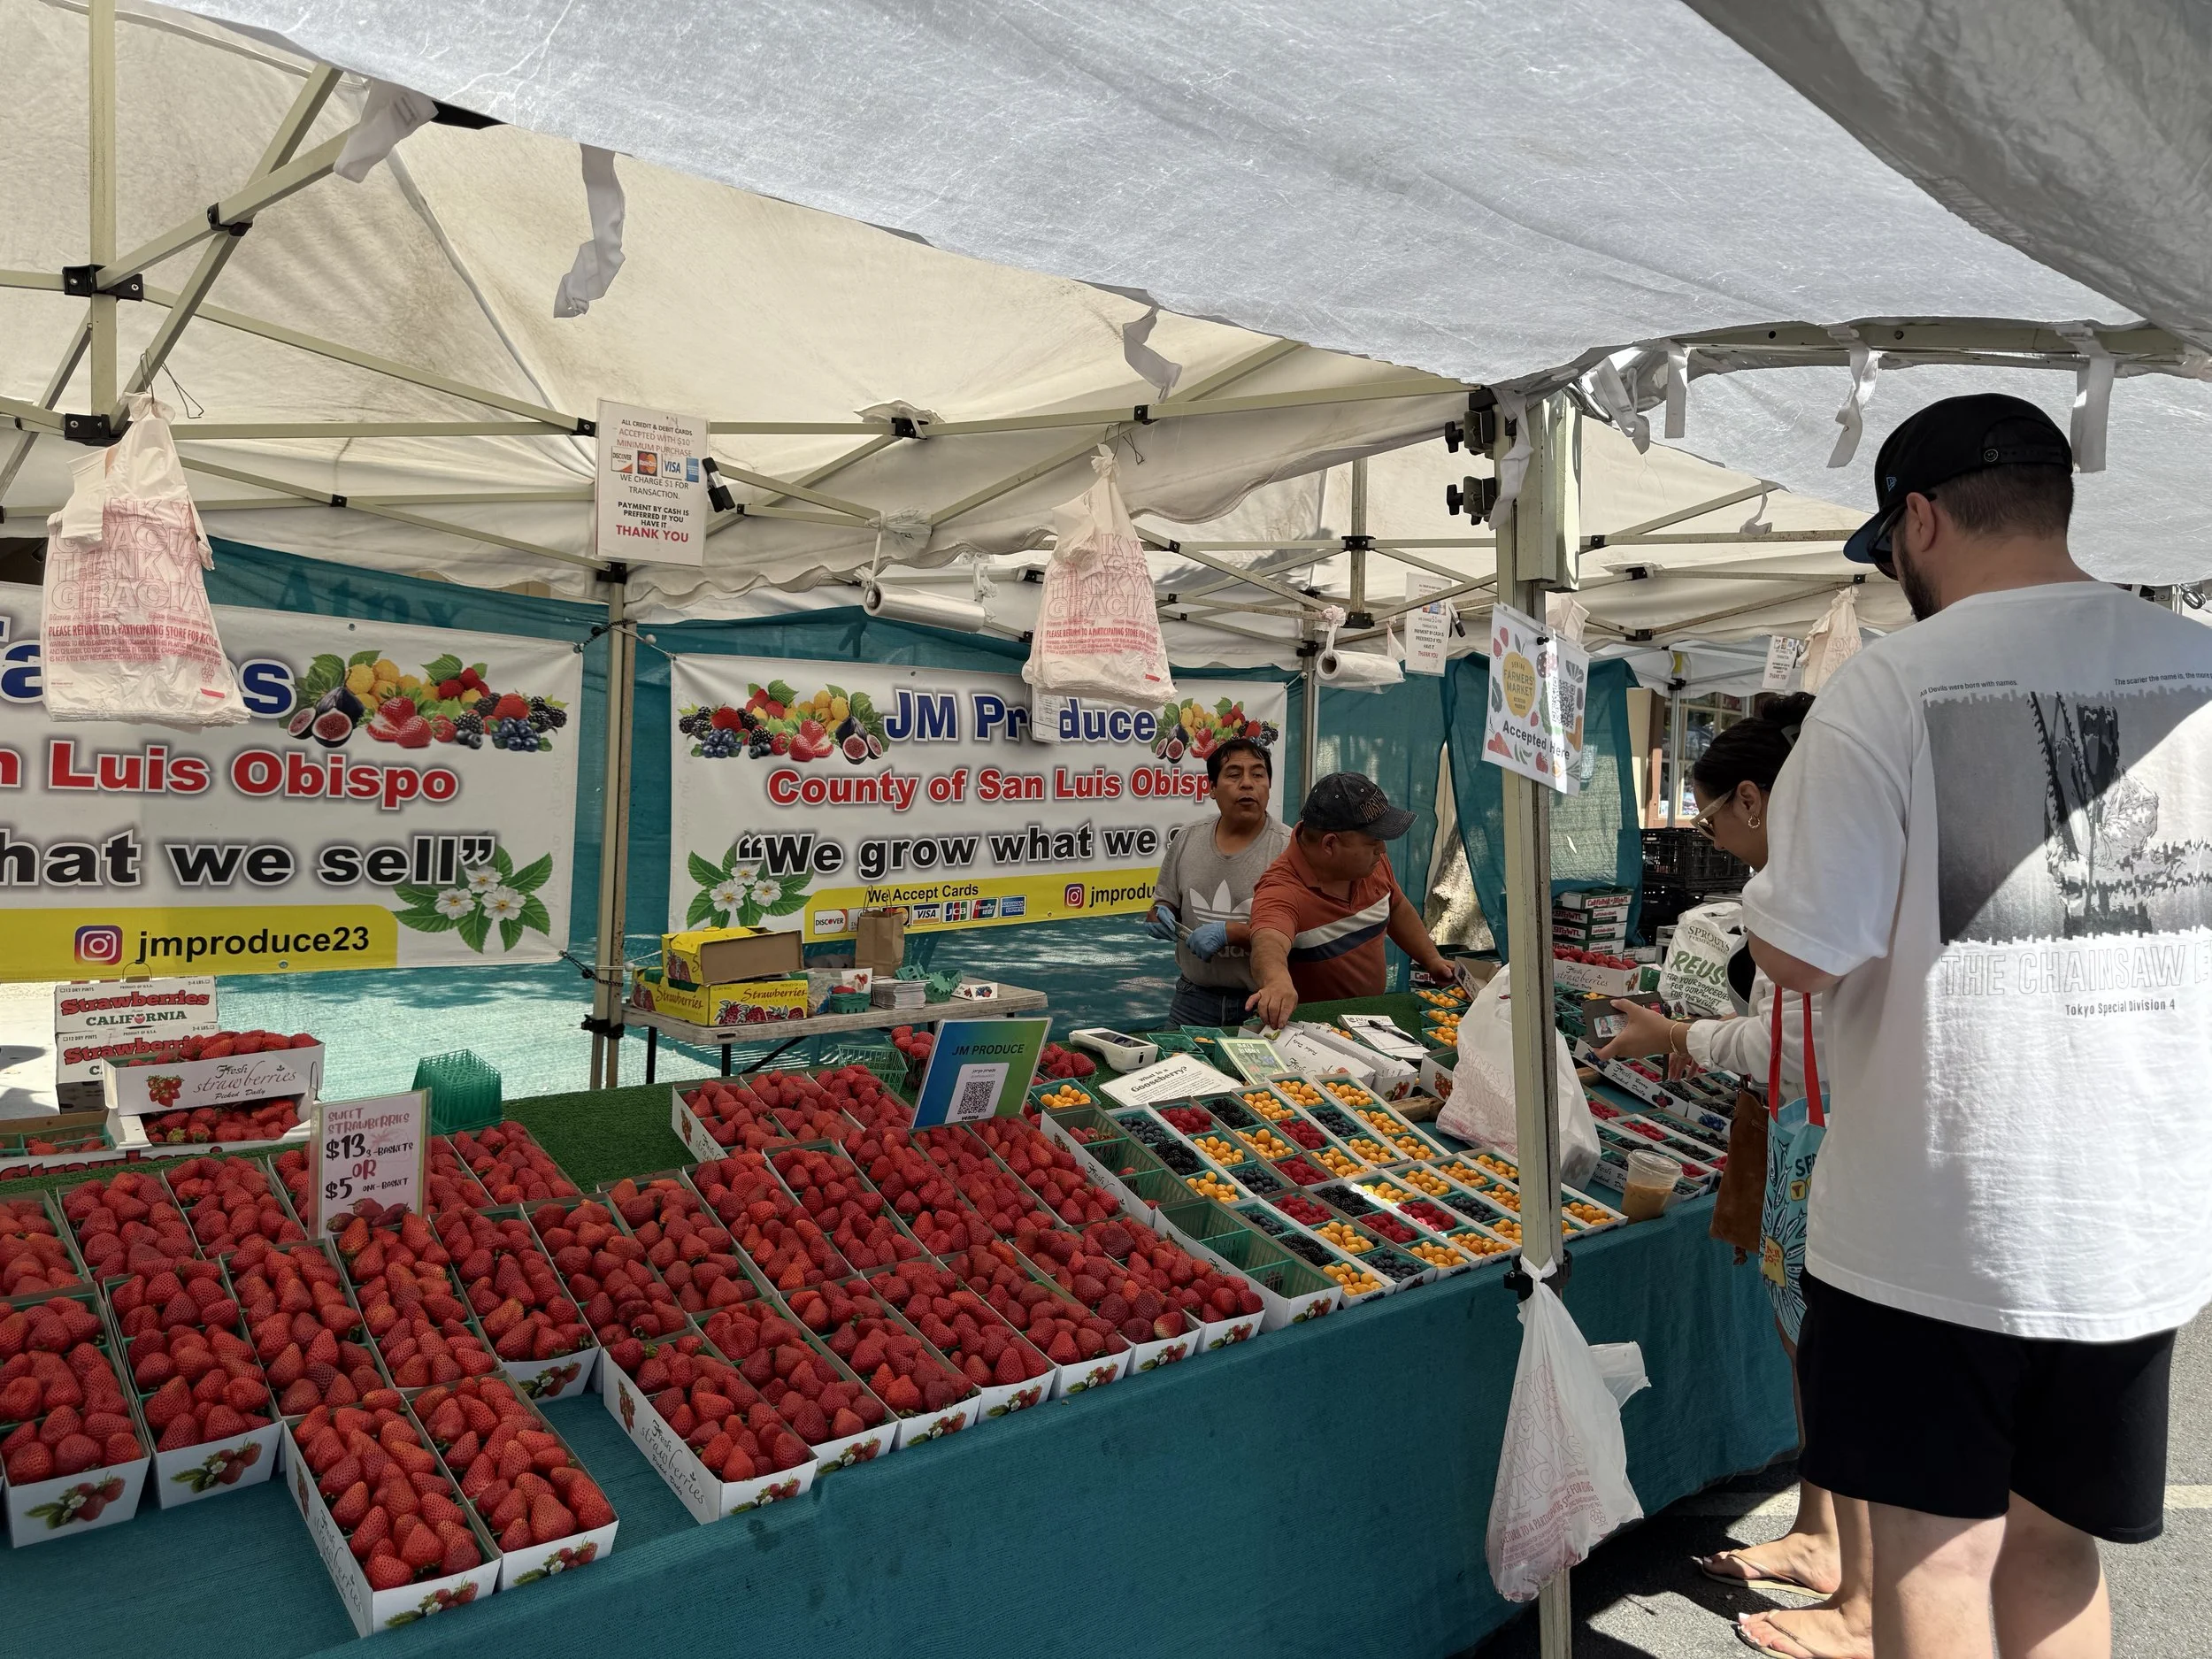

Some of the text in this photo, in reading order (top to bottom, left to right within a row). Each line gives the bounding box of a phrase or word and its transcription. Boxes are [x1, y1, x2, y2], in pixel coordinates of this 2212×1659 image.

[618, 428, 691, 446] ACCEPTED WITH $10
[632, 420, 651, 429] CREDIT
[675, 427, 693, 436] CARDS
[617, 439, 693, 457] MINIMUM PURCHASE
[664, 460, 681, 474] VISA
[619, 473, 633, 482] WE
[634, 475, 664, 486] CHARGE
[675, 480, 689, 489] FOR
[628, 486, 680, 500] TRANSACTION.
[618, 501, 652, 511] PAYMENT
[664, 506, 682, 515] CASH
[623, 510, 660, 519] PREFERRED
[616, 525, 689, 542] THANK YOU
[52, 579, 207, 617] GRACIA
[49, 626, 71, 637] PLEASE
[73, 625, 99, 636] RETURN
[100, 624, 109, 634] TO
[111, 625, 117, 635] A
[1507, 682, 1532, 698] MARKET
[883, 688, 960, 742] JM
[973, 693, 1156, 743] Prduce
[1502, 720, 1571, 760] Accepted Here
[49, 740, 211, 795] Luis
[231, 749, 459, 810] Obispo
[767, 767, 1211, 811] County of San Luis Obisp
[0, 828, 142, 886] hat
[165, 844, 296, 886] we
[858, 836, 977, 880] grow
[990, 822, 1094, 863] what
[1103, 827, 1158, 856] we
[868, 884, 979, 904] We Accept Cards
[1089, 883, 1155, 907] jmprodu
[917, 909, 936, 919] VISA
[947, 906, 967, 917] JCB
[815, 917, 844, 926] DISCOVER
[135, 926, 369, 964] jmproduce23
[1687, 926, 1731, 952] SPROUTS
[1555, 968, 1608, 987] strawberries
[1671, 950, 1727, 987] REUS
[1941, 955, 2006, 996] THE
[2018, 945, 2185, 995] CHAINSAW
[1671, 982, 1699, 995] FOR OUR
[1679, 976, 1698, 987] YOUR
[60, 989, 211, 1016] Strawberries
[656, 985, 703, 1010] Strawberries
[741, 987, 807, 1002] Strawberries
[1671, 990, 1683, 999] FOR
[2065, 999, 2175, 1018] Tokyo Special Division 4
[63, 1035, 192, 1065] Strawberri
[952, 1044, 1025, 1056] JM PRODUCE
[193, 1061, 296, 1093] strawberries
[215, 1064, 248, 1079] Fresh
[1130, 1065, 1188, 1093] Gooseberry?
[1138, 1072, 1155, 1082] What
[215, 1091, 240, 1100] Picked
[1632, 1084, 1646, 1096] Daily
[327, 1112, 410, 1134] STRAWBERRIES
[328, 1108, 364, 1122] SWEET
[326, 1133, 366, 1161] $13
[352, 1159, 377, 1180] OR
[1087, 1162, 1105, 1185] Fresh
[325, 1177, 352, 1201] $5
[652, 1419, 672, 1452] Fresh
[641, 1426, 705, 1505] strawberries
[1521, 1526, 1530, 1536] TO
